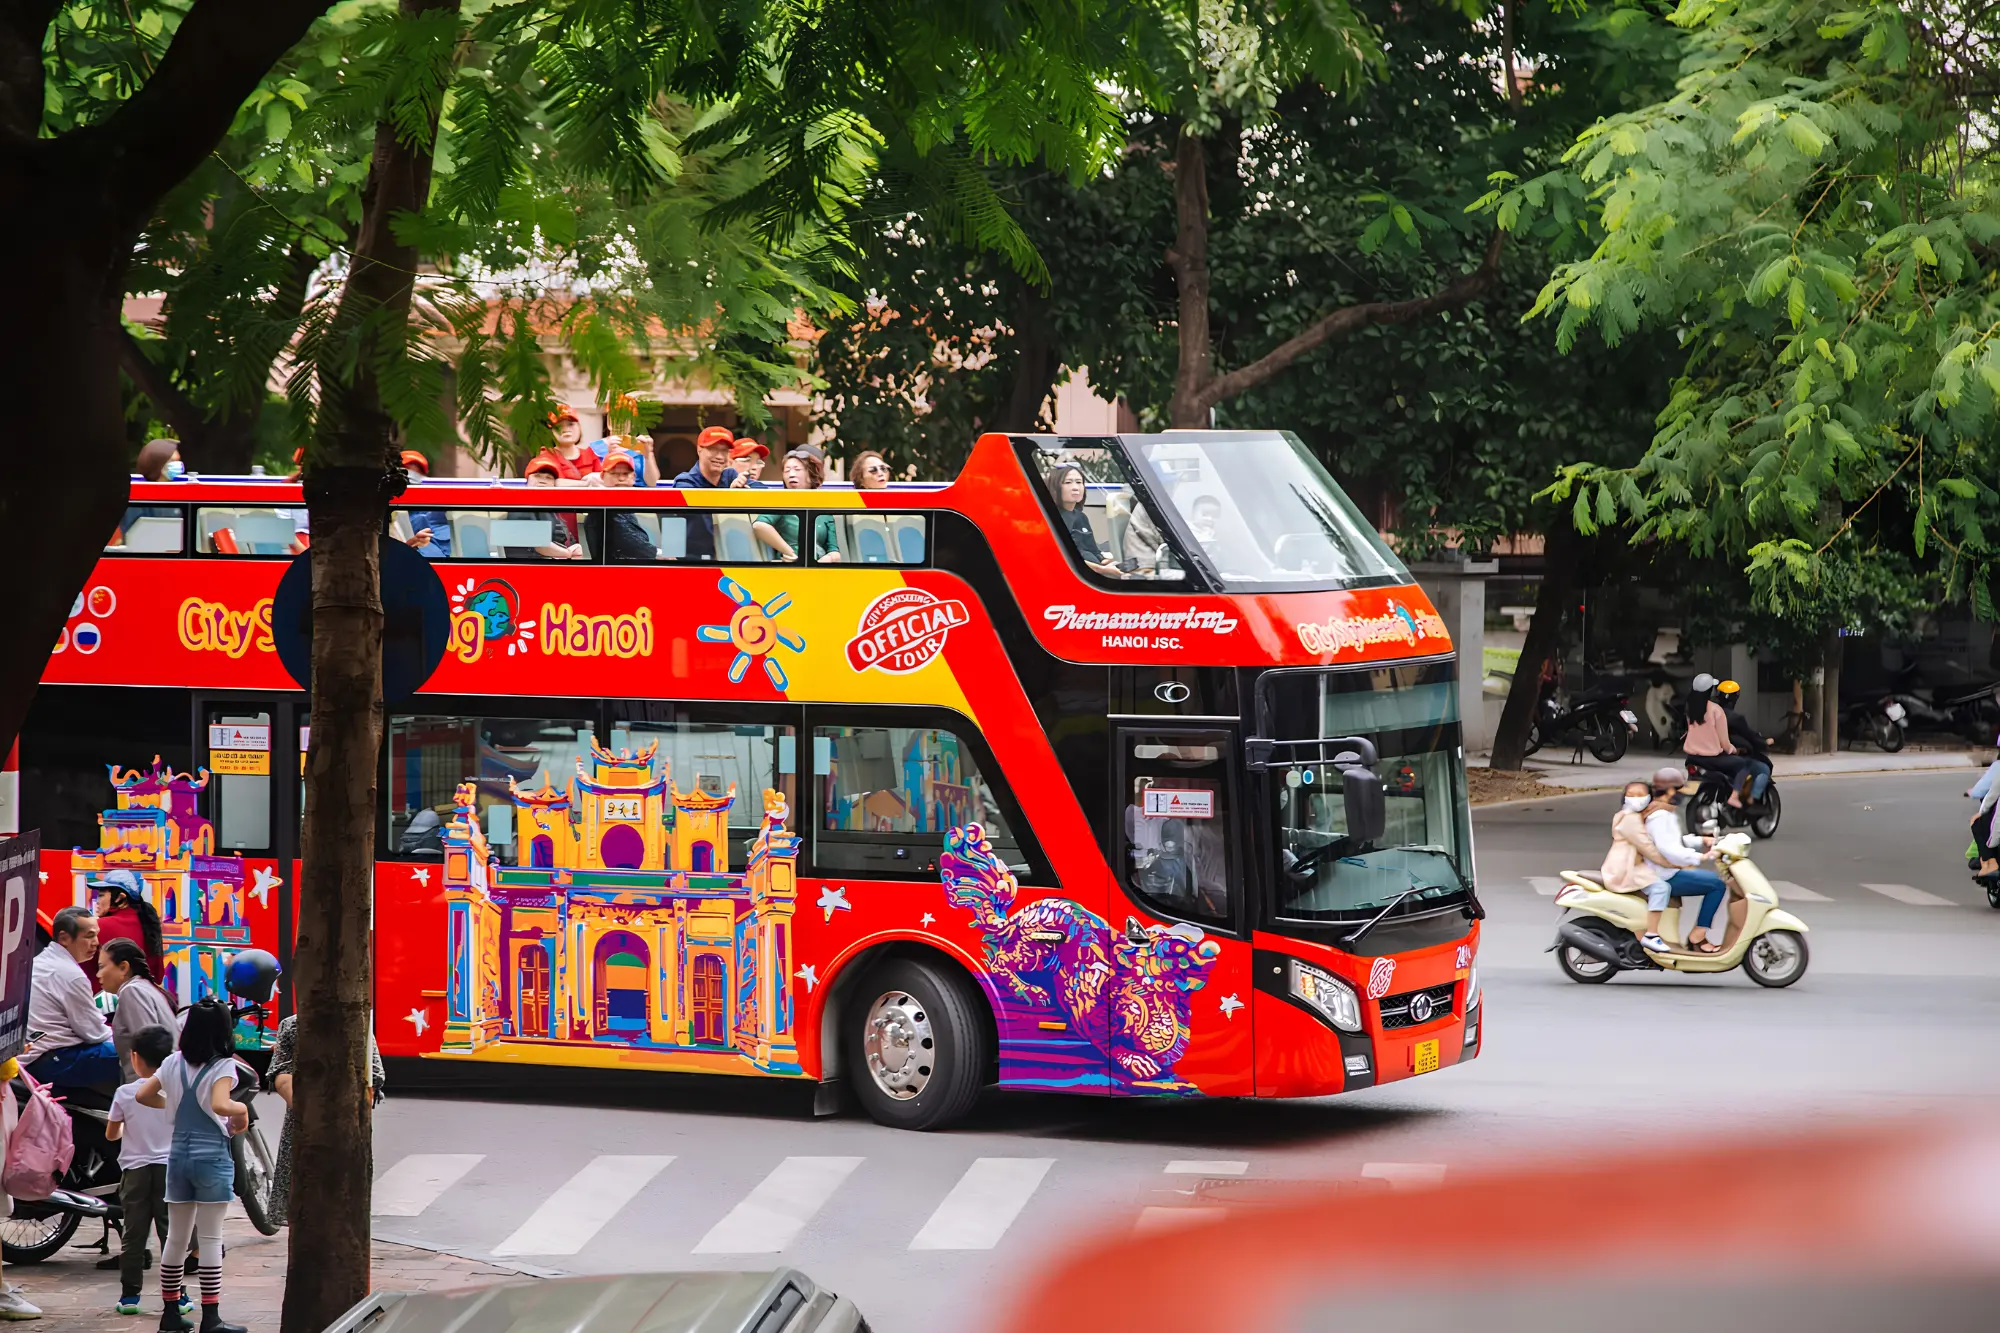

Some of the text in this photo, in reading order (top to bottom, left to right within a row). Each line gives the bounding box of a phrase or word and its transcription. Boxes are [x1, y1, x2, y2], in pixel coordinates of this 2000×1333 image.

[540, 602, 654, 659] Hanoi
[857, 604, 963, 662] OFFICIAL
[893, 638, 941, 668] TOUR
[1102, 635, 1184, 650] HANOI JSC.
[0, 876, 26, 1003] P
